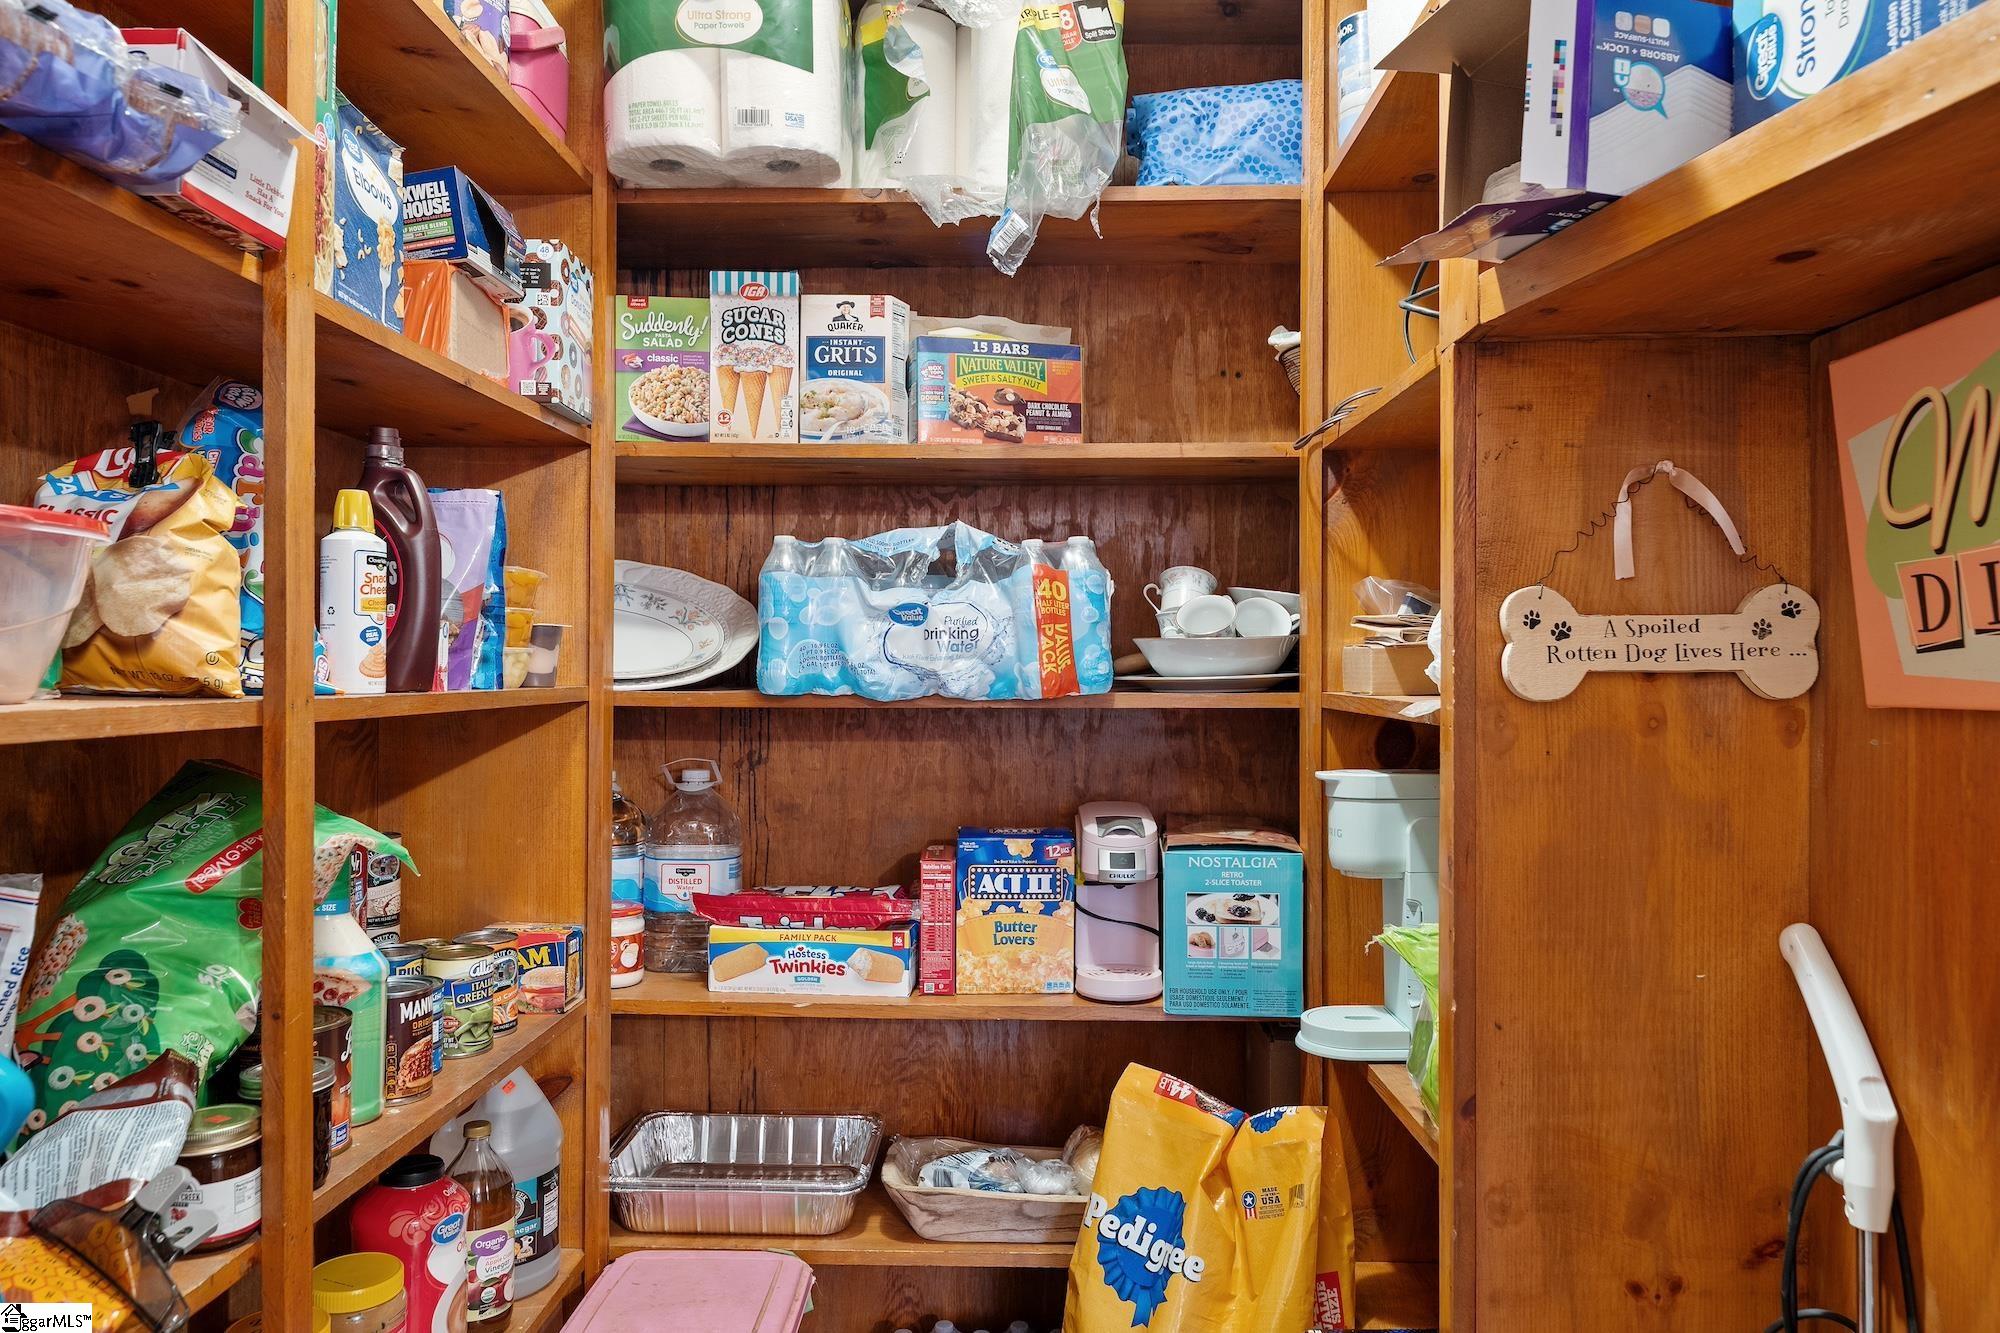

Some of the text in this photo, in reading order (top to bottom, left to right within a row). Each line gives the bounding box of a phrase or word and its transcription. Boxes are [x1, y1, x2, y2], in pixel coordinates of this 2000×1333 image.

[687, 9, 752, 22] Ultra Strong
[1060, 9, 1074, 29] 8
[1838, 0, 1849, 29] Dra
[694, 21, 745, 31] Paper Towels
[1614, 31, 1669, 47] MULTI-SURFACE
[1640, 48, 1680, 62] ABSORB
[1755, 28, 1769, 91] Great
[249, 173, 266, 188] Little
[257, 188, 268, 199] Has
[352, 166, 392, 210] Elbows
[245, 190, 273, 211] Snack For
[403, 196, 451, 219] HOUSE
[409, 221, 448, 233] HOUSE BLEND
[539, 246, 550, 254] 48
[743, 286, 766, 298] IGA
[722, 306, 784, 329] SUGAR
[620, 312, 709, 347] Suddenly!
[722, 323, 785, 345] CONES
[827, 322, 864, 332] QUAKER
[643, 337, 683, 348] SALAD
[972, 341, 1030, 355] 15 BARS
[647, 353, 679, 363] classic
[814, 345, 877, 365] GRITS
[827, 369, 863, 377] ORIGINAL
[959, 357, 1003, 376] NATURE
[1003, 358, 1044, 380] VALLEY
[962, 374, 990, 386] SWEET
[998, 375, 1023, 386] SALTY
[1023, 378, 1041, 389] NUT
[719, 414, 730, 423] 12
[1039, 579, 1067, 601] 40
[1036, 600, 1069, 609] HALF LITER
[1041, 607, 1066, 616] BOTTLES
[944, 615, 979, 628] Purified
[1604, 618, 1700, 639] A Spoiled
[924, 627, 979, 641] Drinking
[1041, 624, 1057, 675] PACK
[1055, 623, 1071, 674] VALUE
[1547, 643, 1781, 664] Rotten Dog Lives Here
[1045, 845, 1061, 857] 12
[1221, 871, 1243, 879] RETRO
[978, 874, 1053, 894] ACT II
[1231, 879, 1262, 887] TOASTER
[322, 903, 337, 911] SIZE
[994, 921, 1038, 933] Butter
[779, 934, 837, 942] FAMILY PACK
[894, 936, 903, 944] 16
[993, 933, 1036, 946] Lovers
[787, 949, 826, 959] Hostess
[10, 946, 31, 977] Rice
[769, 959, 846, 976] Twinkies
[457, 990, 487, 1004] GREEN
[1170, 1080, 1192, 1100] 44
[181, 1193, 200, 1201] CREEK
[1261, 1196, 1280, 1205] USA
[437, 1218, 461, 1235] Great
[475, 1234, 506, 1249] Organic
[1084, 1193, 1205, 1282] Pedigree
[485, 1260, 510, 1273] Vinegar
[1327, 1288, 1341, 1324] SIZE
